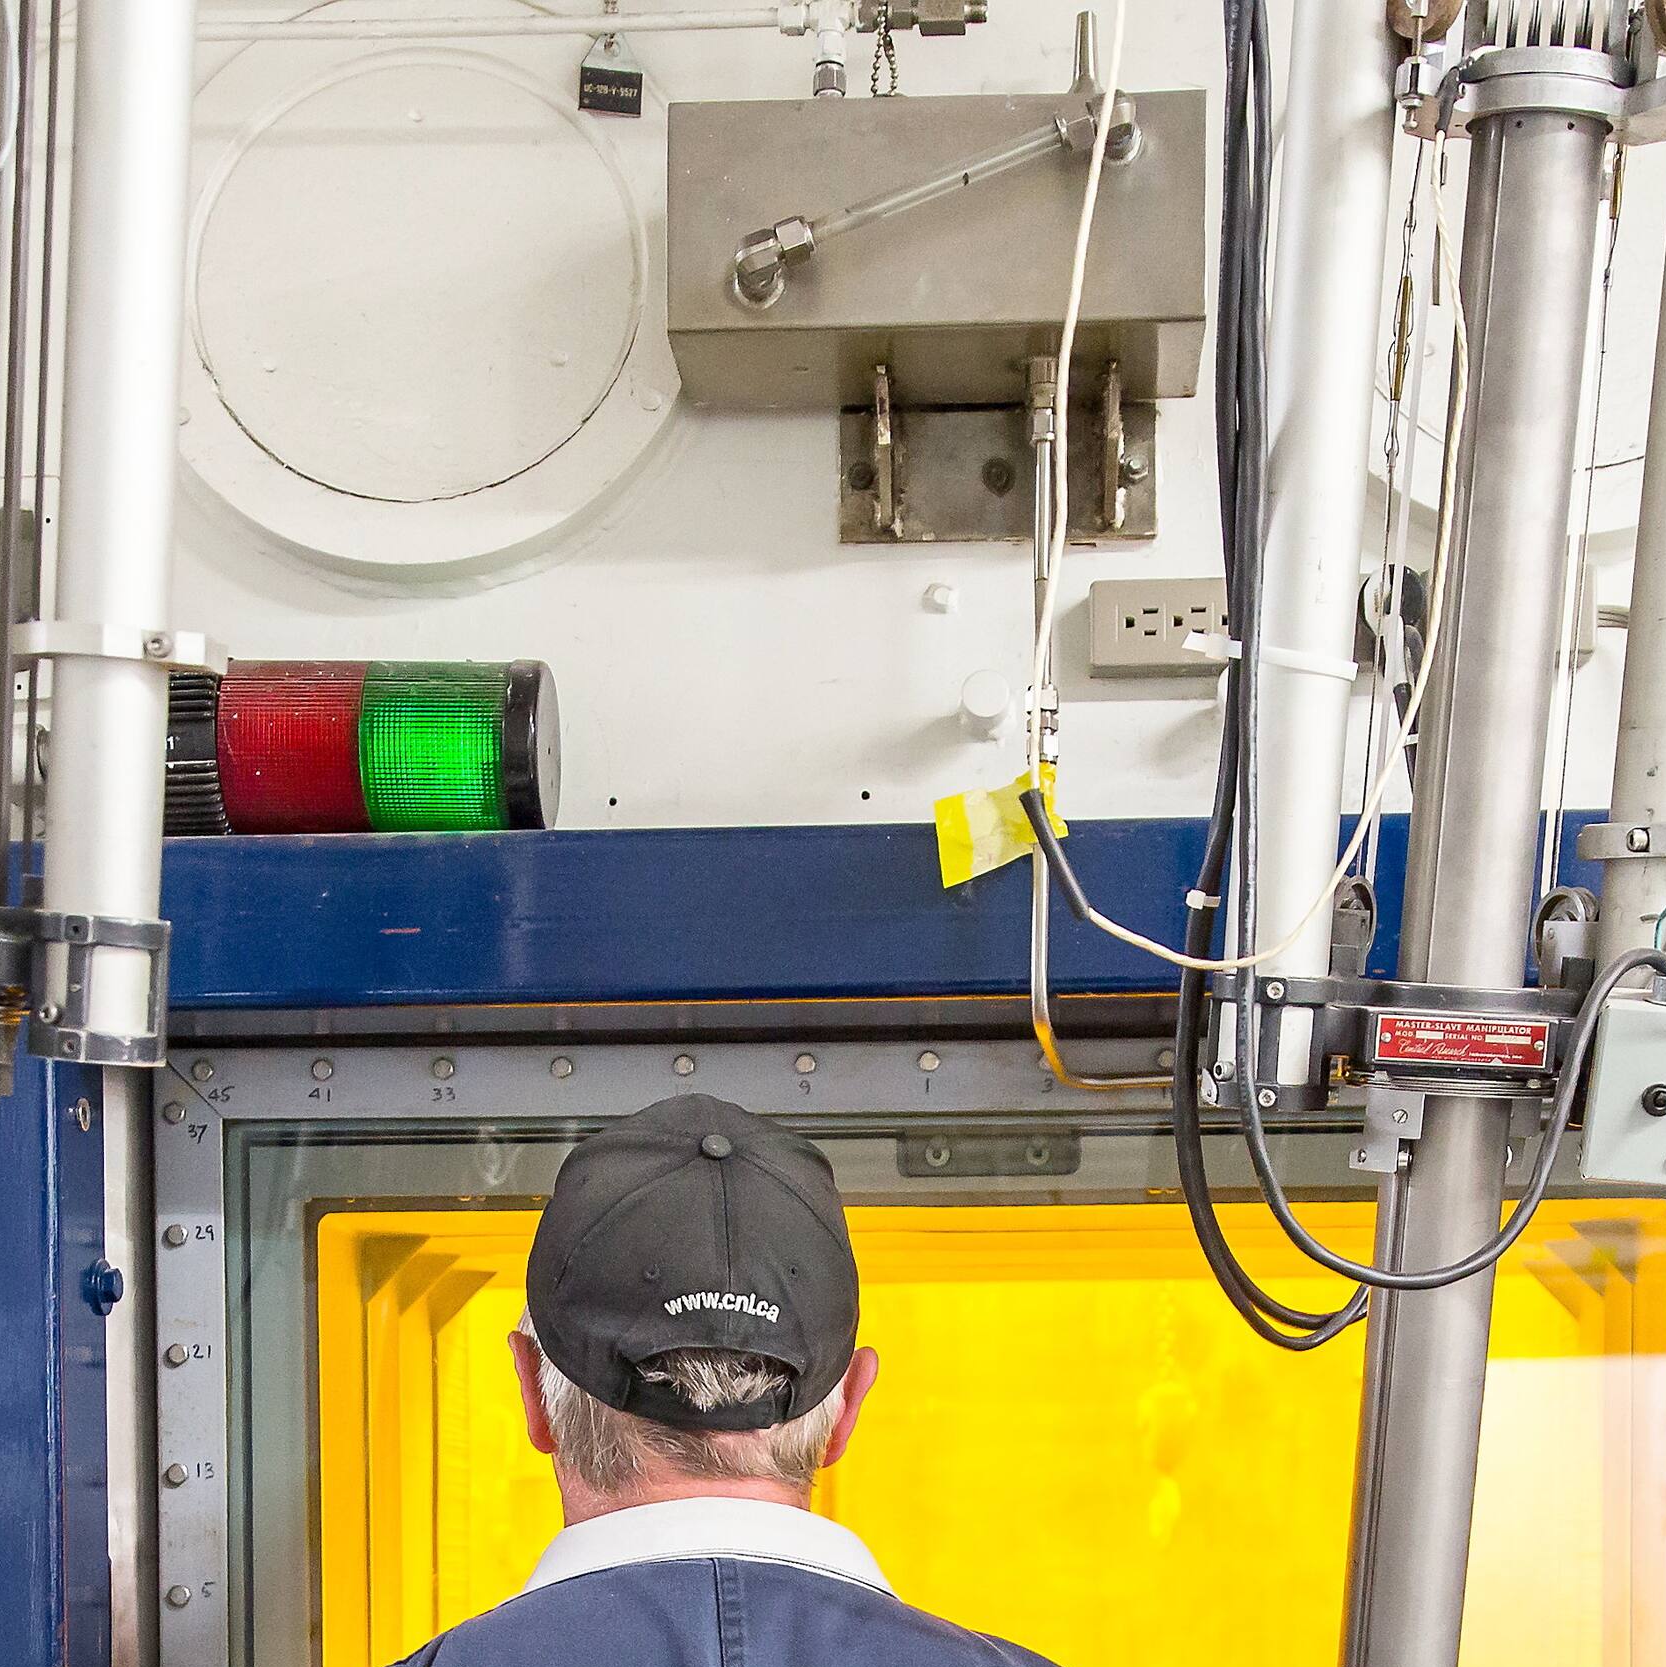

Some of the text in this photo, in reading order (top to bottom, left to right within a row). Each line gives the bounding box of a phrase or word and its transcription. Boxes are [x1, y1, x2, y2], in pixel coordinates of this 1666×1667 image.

[1395, 1020, 1532, 1036] MASTER-SLAVE MANIPULATOR
[1395, 1030, 1415, 1038] MOD.
[209, 1086, 235, 1102] 45
[309, 1087, 332, 1102] 41
[432, 1087, 456, 1102] 33
[798, 1079, 811, 1096] 9
[187, 1125, 210, 1144] 37
[195, 1225, 215, 1241] 29
[664, 1291, 780, 1323] www.cnl.ca
[192, 1344, 212, 1359] 21
[196, 1462, 214, 1480] 13
